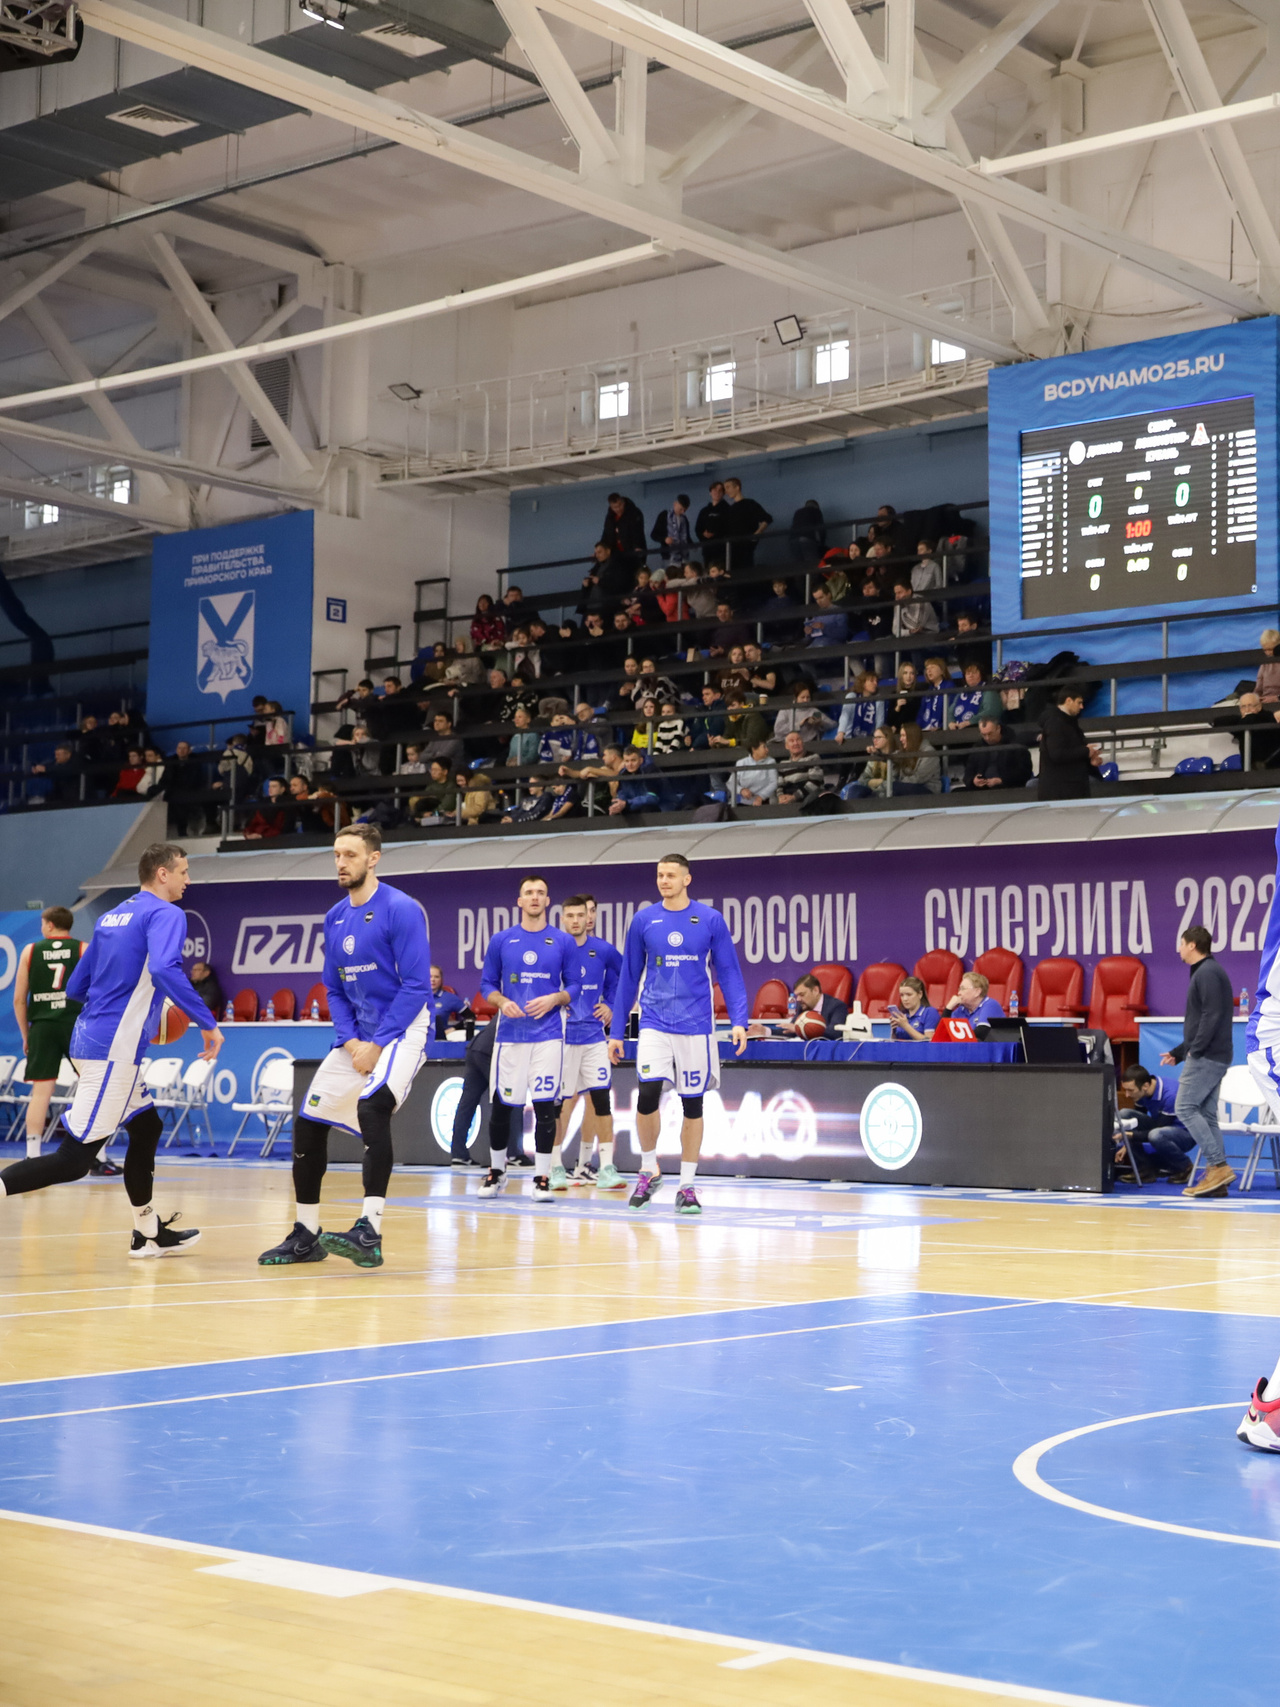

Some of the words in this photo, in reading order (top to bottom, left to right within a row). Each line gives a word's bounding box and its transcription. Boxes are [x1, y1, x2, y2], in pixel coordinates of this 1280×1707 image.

[1044, 353, 1225, 401] BCDYNAMO25.RU
[1175, 482, 1190, 507] 0
[1088, 495, 1102, 519] 0
[191, 556, 264, 576] ПРАВИТЕЛЬСТВА
[192, 554, 209, 564] ПРИ
[184, 569, 247, 587] ПРИМОРСКОГО
[248, 565, 272, 577] КРАЯ
[722, 892, 857, 964] РОССИИ
[924, 880, 1153, 959] СУПЕРЛИГА
[181, 937, 206, 958] ФБ
[47, 963, 66, 990] 7
[948, 1020, 974, 1040] 5
[534, 1075, 555, 1092] 25
[682, 1070, 701, 1088] 15
